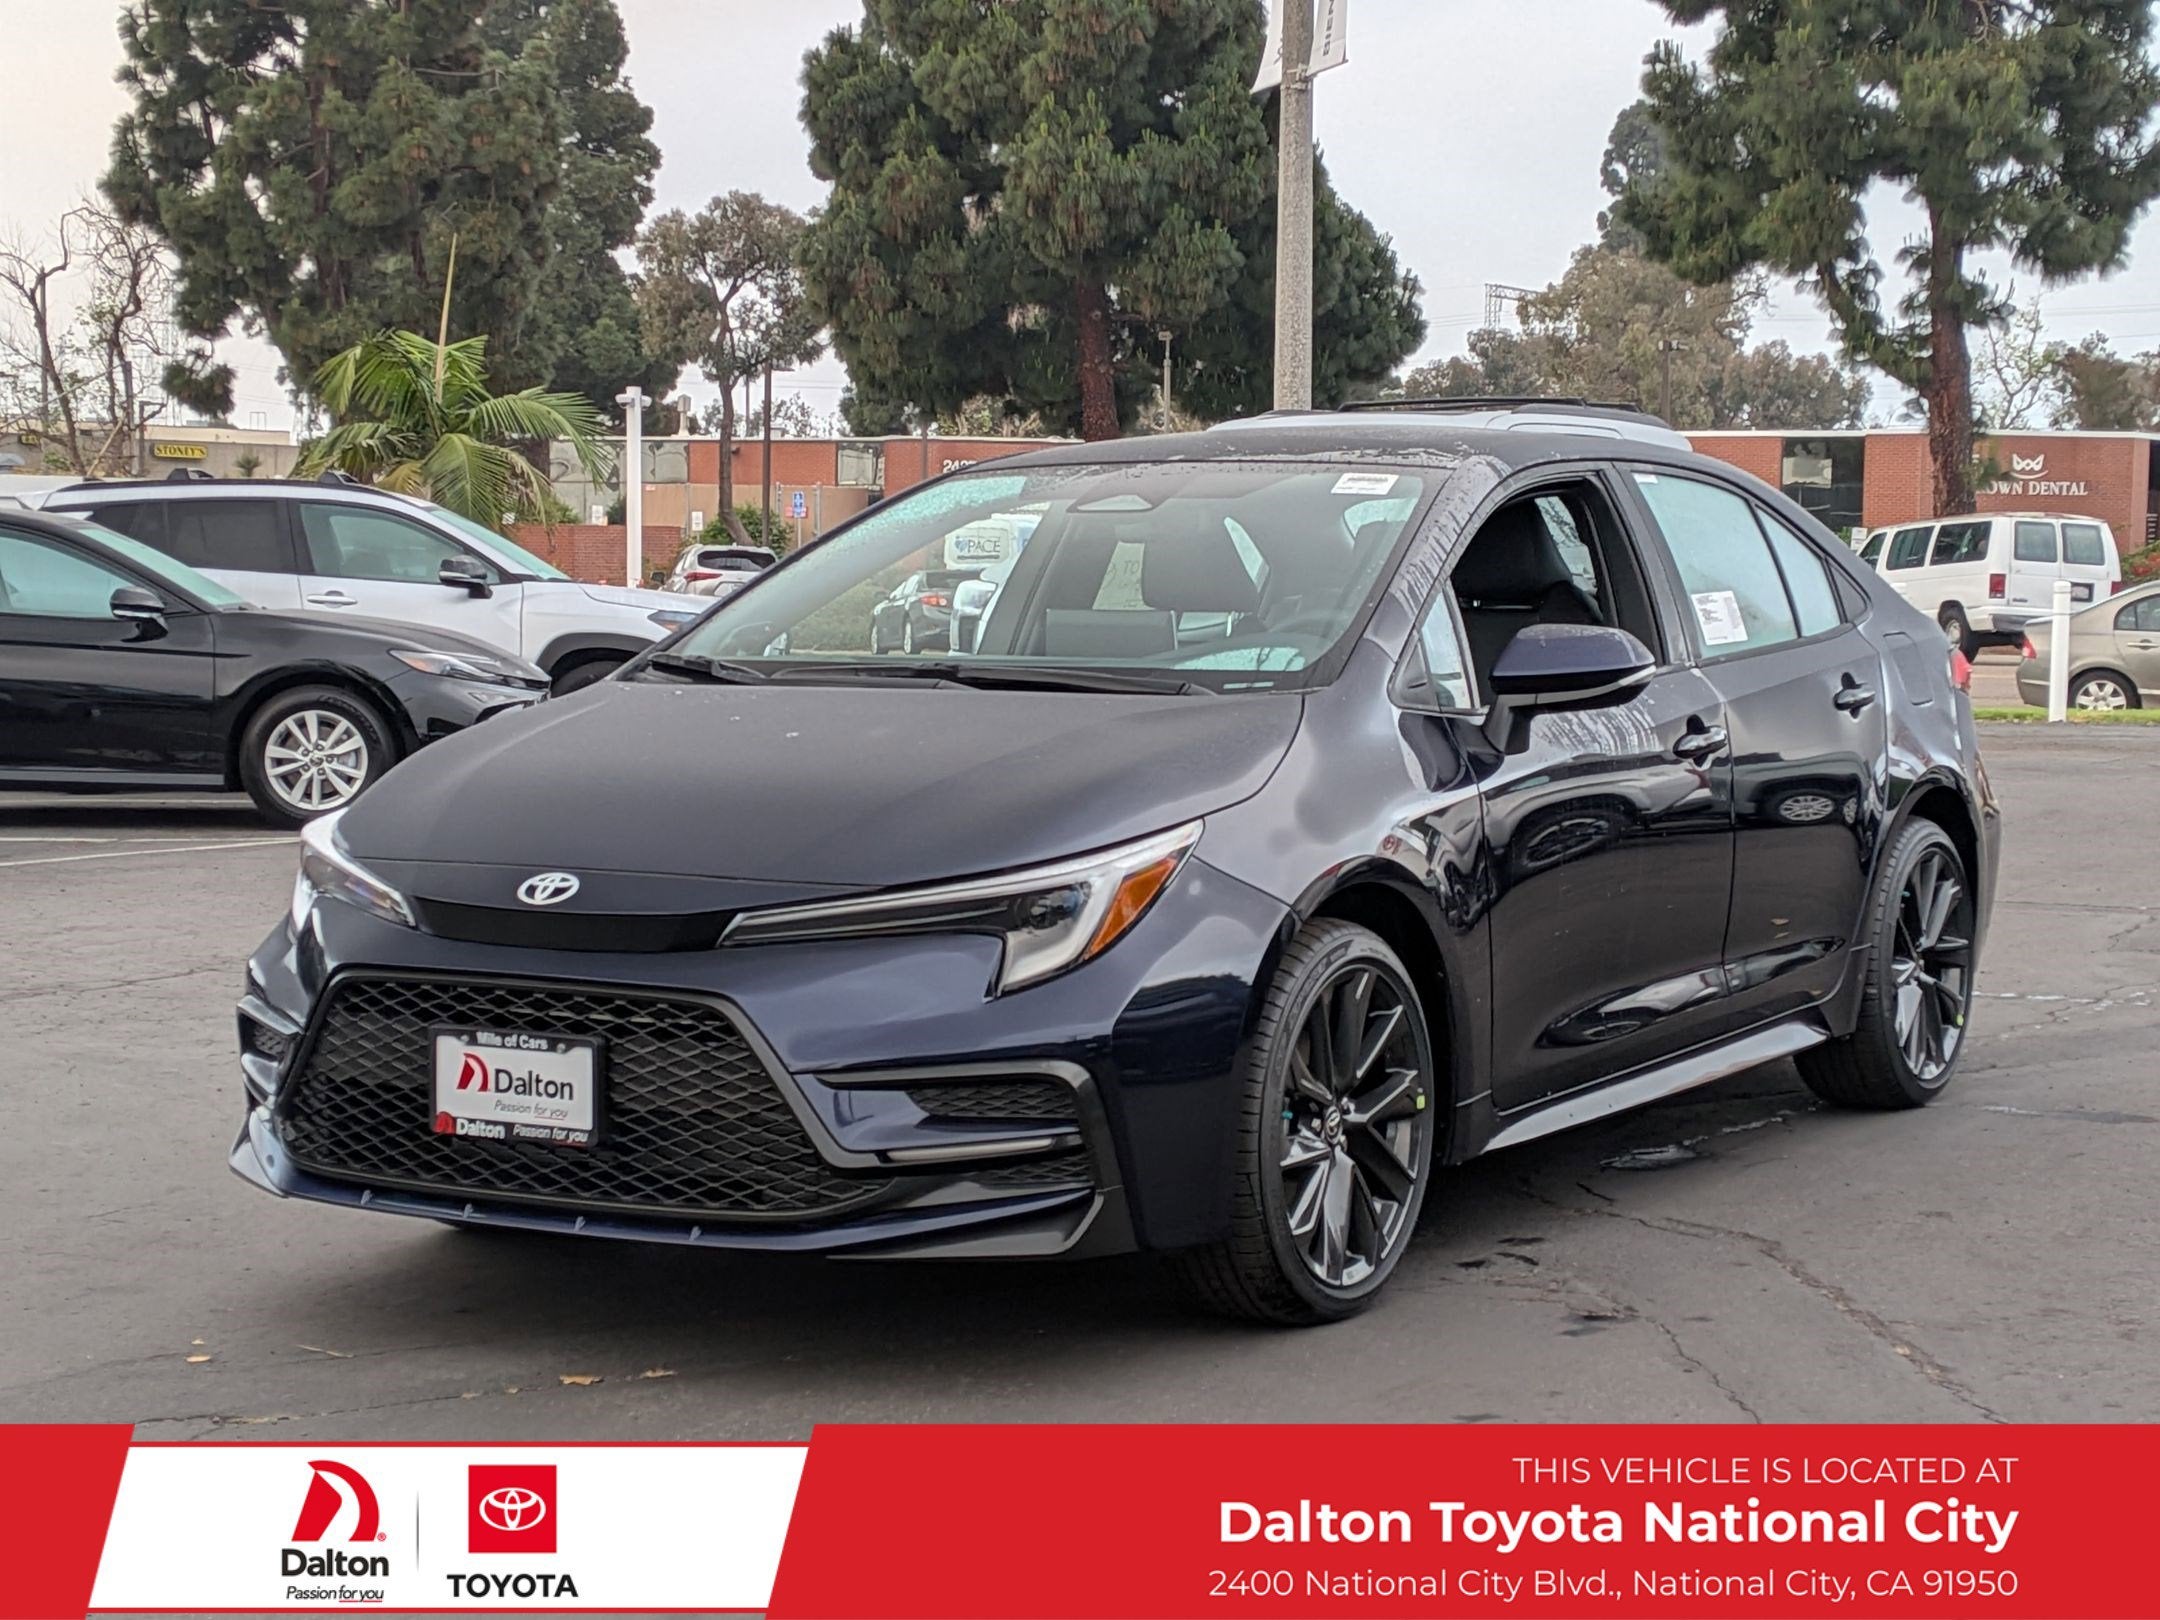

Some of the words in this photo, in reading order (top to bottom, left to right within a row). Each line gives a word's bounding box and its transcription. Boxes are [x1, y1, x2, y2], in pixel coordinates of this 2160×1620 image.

[2028, 481, 2088, 496] DENTAL
[967, 539, 1001, 553] PACE
[476, 1031, 502, 1046] Mile
[504, 1034, 518, 1047] of
[519, 1035, 549, 1050] Cars
[494, 1068, 574, 1101] Dalton
[494, 1100, 532, 1115] Passion
[533, 1104, 549, 1116] for
[549, 1107, 568, 1119] you
[456, 1118, 506, 1140] Dalton
[513, 1124, 552, 1139] Passion
[552, 1127, 568, 1141] for
[566, 1130, 589, 1144] you
